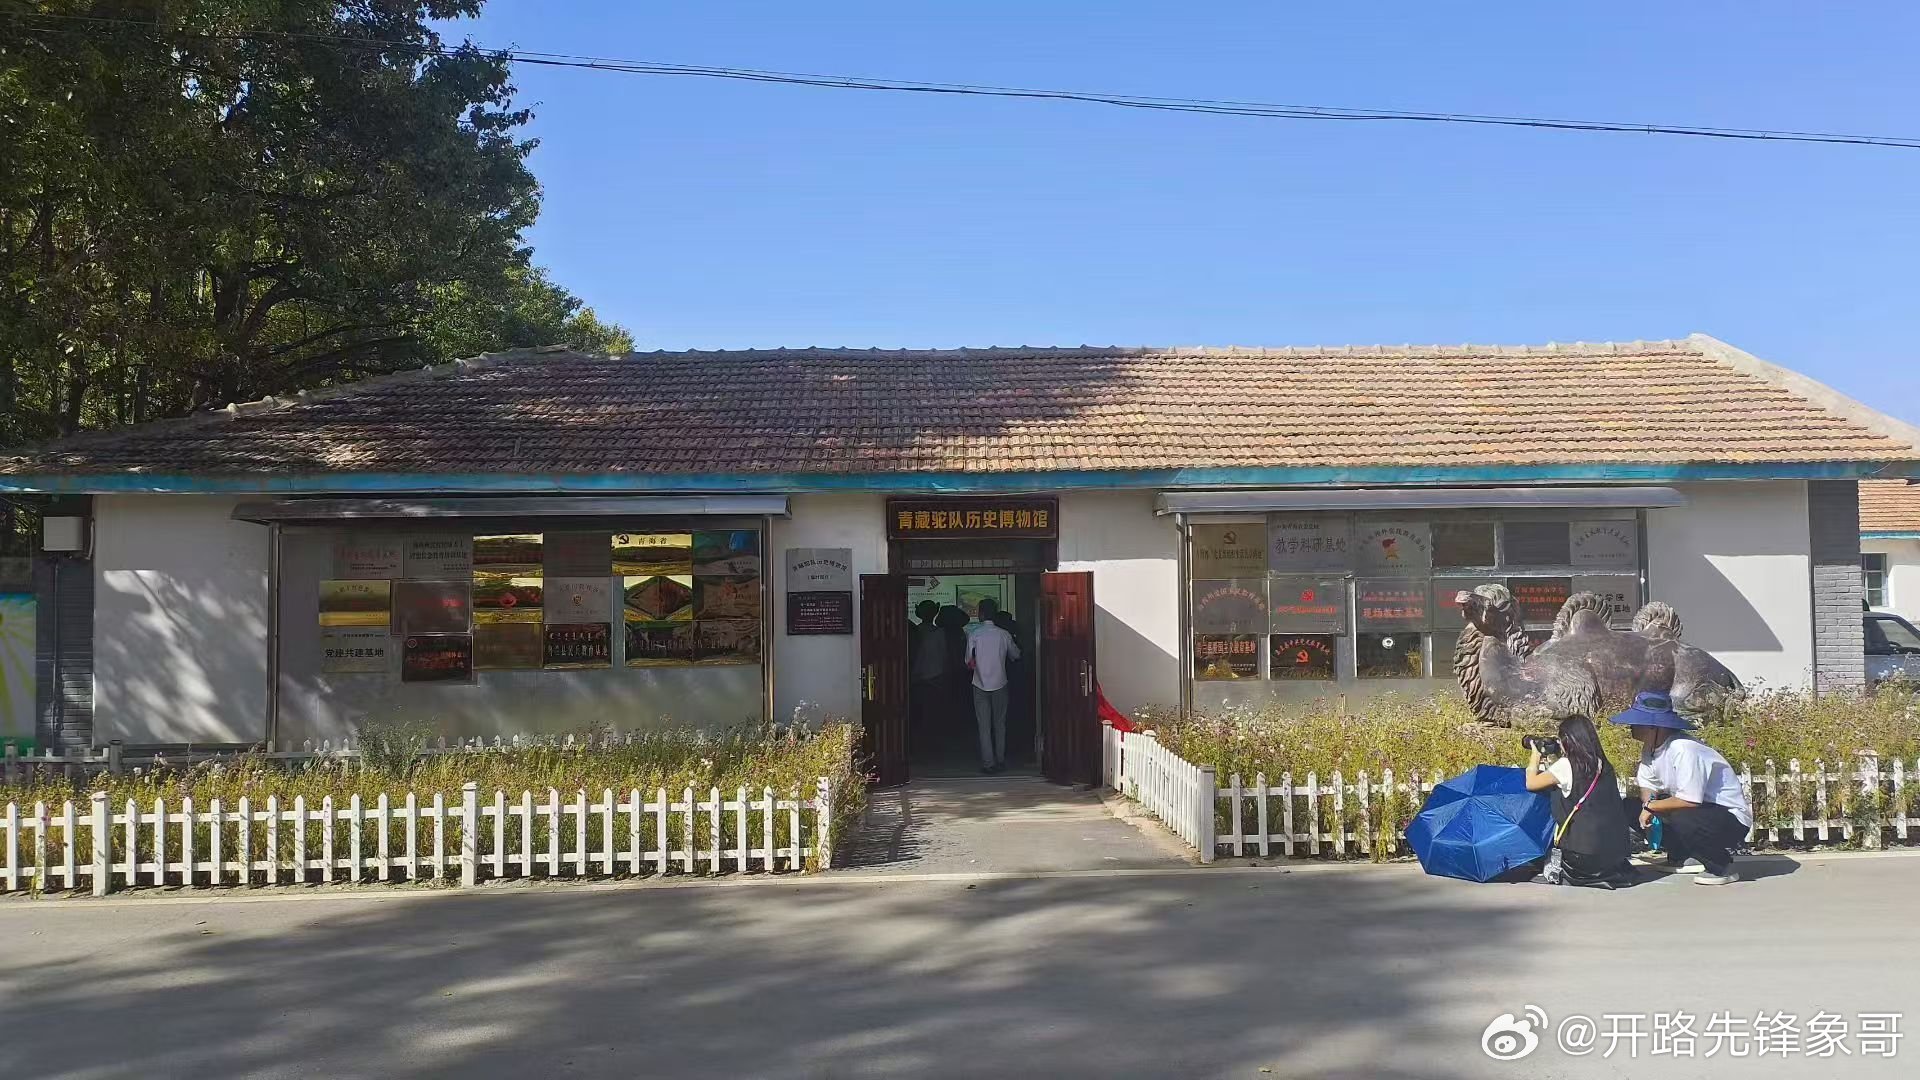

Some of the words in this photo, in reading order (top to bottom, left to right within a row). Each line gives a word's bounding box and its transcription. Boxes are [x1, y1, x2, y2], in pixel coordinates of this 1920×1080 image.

[898, 510, 1048, 529] 青藏驼队历史博物馆
[325, 648, 384, 658] 党建共建基地
